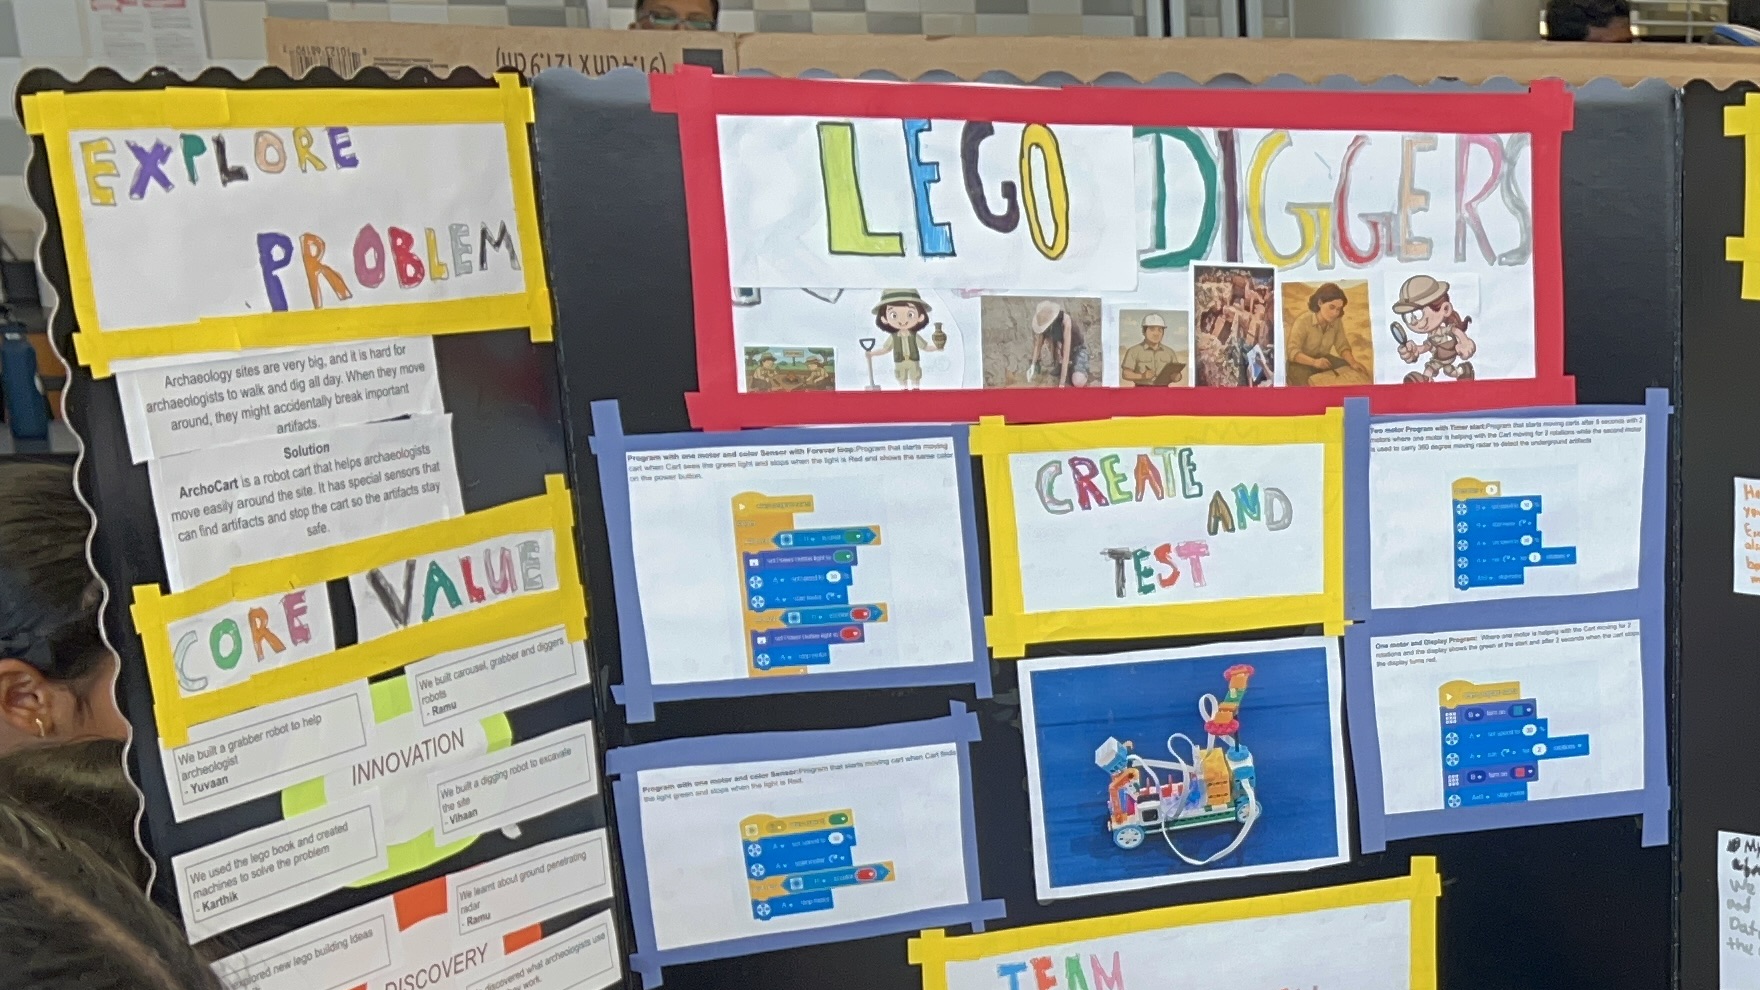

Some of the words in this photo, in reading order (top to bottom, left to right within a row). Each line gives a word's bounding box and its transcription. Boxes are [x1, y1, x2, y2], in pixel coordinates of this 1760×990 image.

[80, 125, 360, 207] EXPLORE
[815, 118, 1070, 262] LEGO
[1134, 125, 1534, 271] DIGGERS
[257, 220, 521, 312] PROBLEM
[145, 390, 225, 414] archaeologists
[226, 388, 238, 401] to
[239, 383, 266, 399] walk
[267, 379, 288, 396] and
[289, 377, 306, 394] dig
[308, 374, 321, 389] all
[322, 373, 344, 388] day.
[345, 369, 376, 384] When
[376, 366, 397, 380] they
[399, 362, 426, 375] move
[164, 368, 233, 389] Archaeology
[235, 365, 261, 379] sites
[262, 362, 281, 376] are
[282, 359, 306, 373] very
[307, 354, 328, 371] big,
[329, 350, 349, 366] and
[349, 349, 358, 363] it
[358, 348, 368, 362] is
[368, 344, 392, 360] hard
[392, 343, 406, 357] for
[170, 412, 213, 431] around,
[214, 410, 239, 425] they
[240, 403, 272, 421] might
[273, 394, 333, 416] accidentally
[334, 389, 364, 405] break
[364, 382, 410, 401] important
[276, 417, 321, 435] artifacts.
[179, 477, 240, 500] ArchoCart
[240, 475, 252, 488] is
[253, 475, 262, 486] a
[262, 468, 291, 485] robot
[291, 464, 312, 480] cart
[312, 460, 333, 476] that
[333, 456, 362, 472] helps
[363, 443, 431, 467] archaeologists
[283, 442, 330, 460] Solution
[170, 506, 201, 523] move
[202, 498, 234, 517] easily
[236, 490, 276, 510] around
[276, 488, 294, 502] the
[295, 485, 317, 499] site.
[317, 481, 327, 494] It
[327, 479, 347, 492] has
[347, 470, 383, 491] special
[383, 465, 421, 482] sensors
[421, 460, 441, 475] that
[177, 529, 198, 543] can
[198, 521, 219, 538] find
[221, 514, 265, 534] artifacts
[267, 509, 287, 525] and
[289, 506, 310, 521] stop
[311, 502, 328, 516] the
[329, 497, 351, 512] cart
[350, 496, 364, 508] so
[364, 492, 381, 505] the
[383, 483, 420, 502] artifacts
[421, 481, 441, 495] stay
[1035, 447, 1204, 515] CREATE
[1206, 482, 1293, 536] AND
[306, 521, 331, 537] safe.
[1100, 540, 1211, 598] TEST
[173, 588, 312, 693] CORE
[369, 539, 545, 630] VALUE
[434, 671, 453, 686] built
[453, 659, 489, 680] carousel,
[489, 650, 519, 671] grabber
[520, 643, 536, 659] and
[536, 637, 565, 654] diggers
[432, 700, 458, 716] Ramu
[196, 745, 218, 761] built
[227, 731, 264, 753] grabber
[265, 722, 290, 739] robot
[301, 714, 322, 728] help
[351, 727, 466, 787] INNOVATION
[190, 775, 229, 794] Yuvaan
[449, 808, 479, 825] Vihaan
[208, 860, 233, 879] used
[233, 857, 249, 870] the
[249, 849, 271, 864] lego
[271, 840, 296, 857] book
[297, 832, 315, 849] and
[315, 821, 349, 842] created
[201, 891, 239, 913] Karthik
